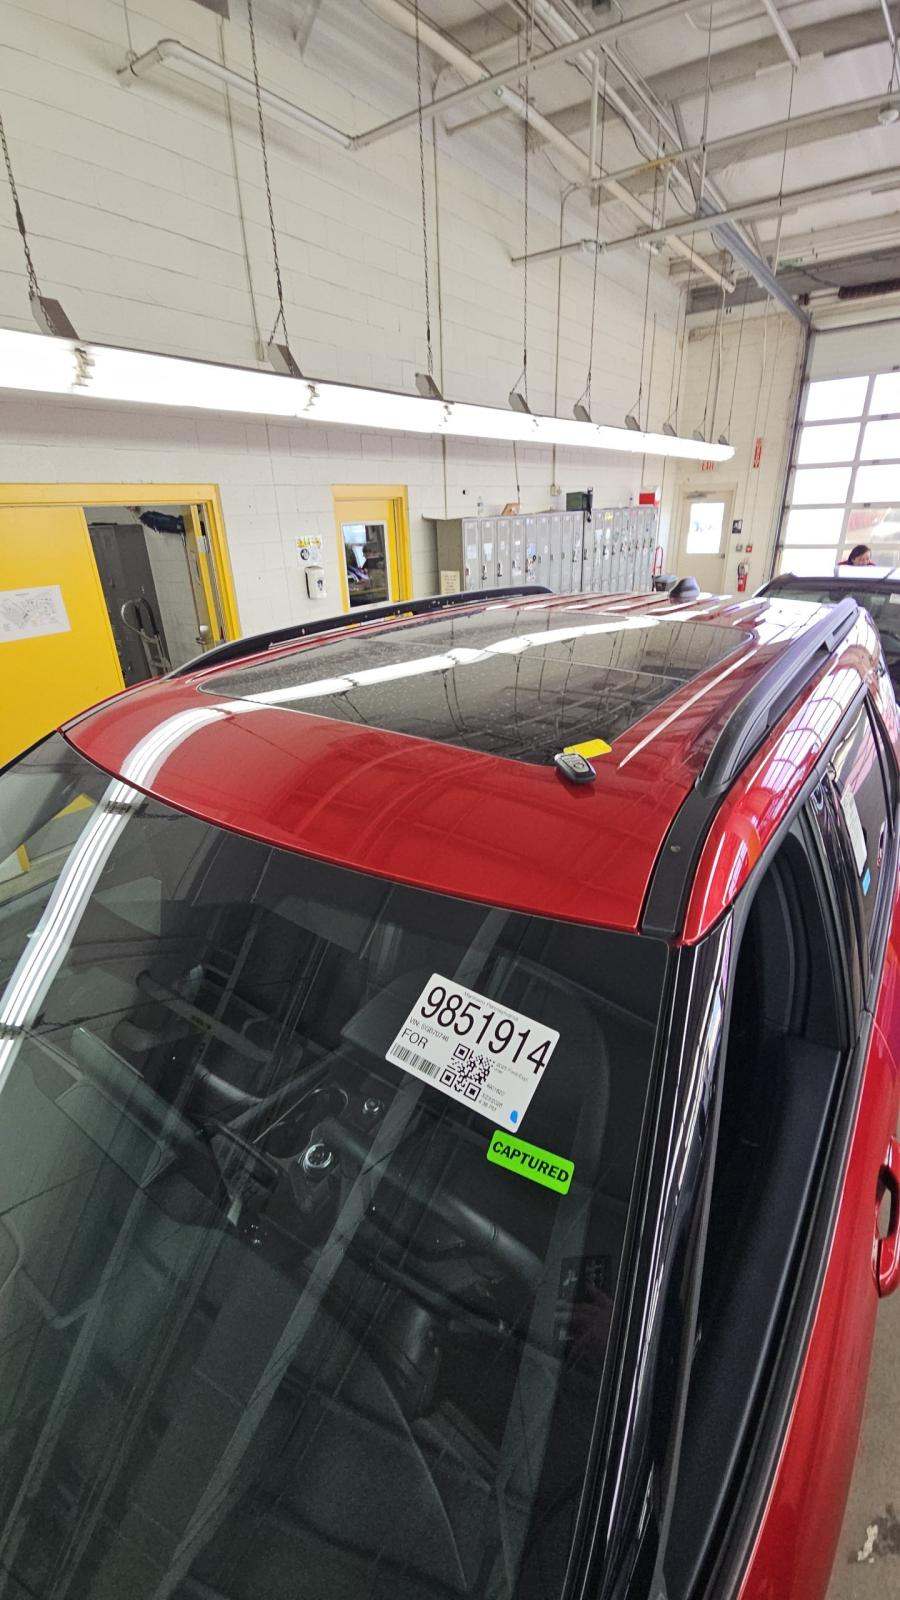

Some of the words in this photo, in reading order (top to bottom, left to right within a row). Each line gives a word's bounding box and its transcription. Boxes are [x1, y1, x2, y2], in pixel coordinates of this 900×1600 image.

[401, 1028, 428, 1049] FOR
[420, 986, 552, 1075] 9851914
[492, 1141, 570, 1184] CAPTURED
